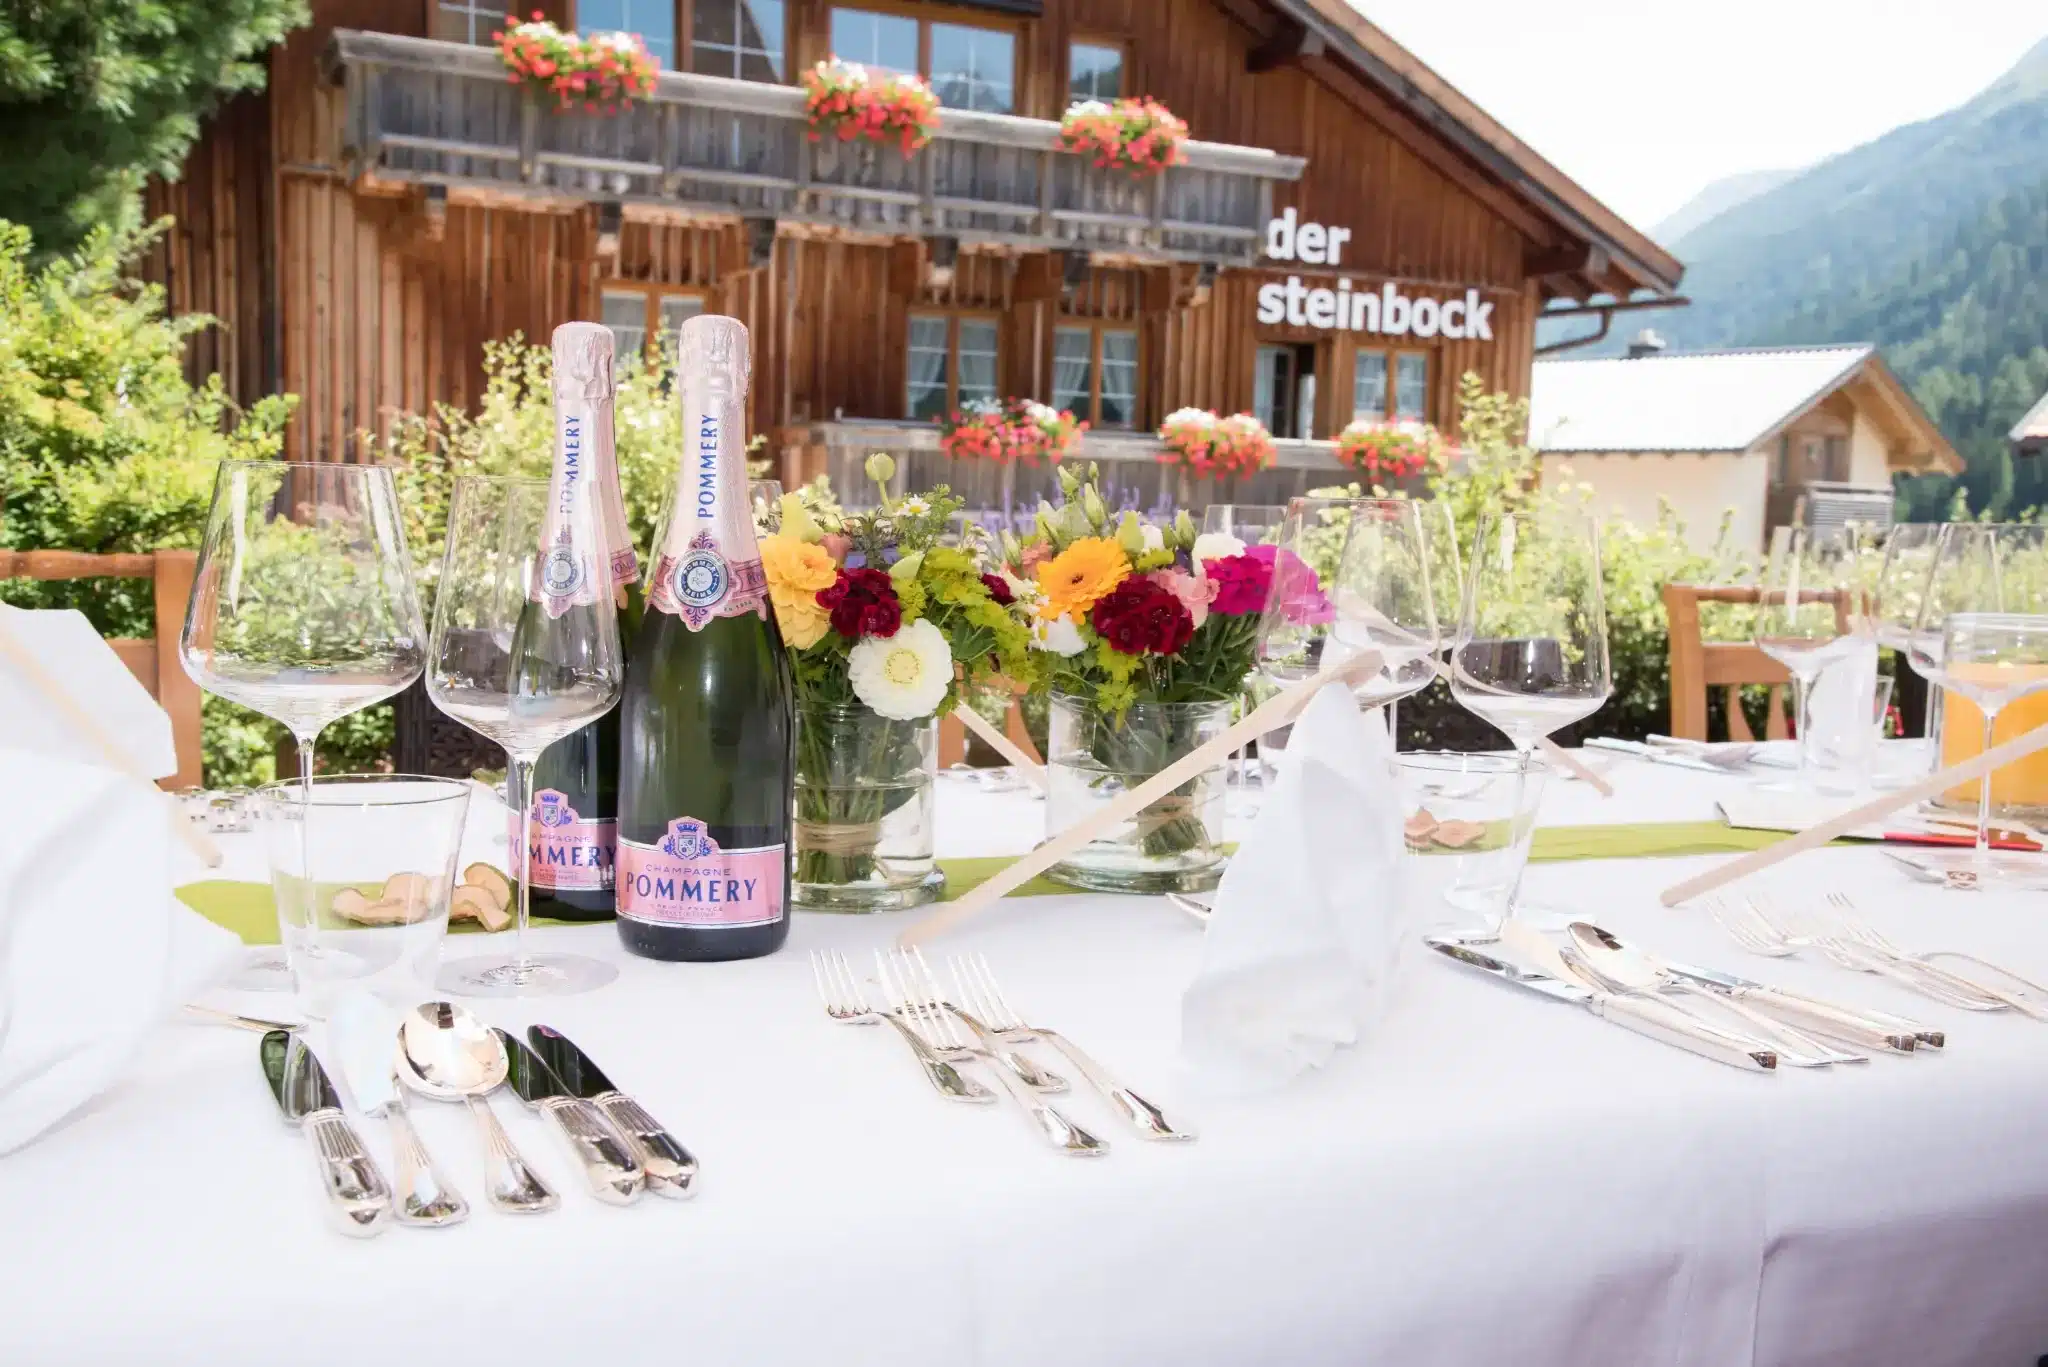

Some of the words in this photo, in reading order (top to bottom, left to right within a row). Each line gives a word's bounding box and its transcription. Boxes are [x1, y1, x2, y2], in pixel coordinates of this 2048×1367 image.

[1266, 206, 1351, 266] der
[1256, 275, 1495, 342] steinbock
[559, 415, 580, 514] POMMERY
[698, 414, 718, 519] POMMERY
[531, 833, 592, 843] AMPAGNE
[626, 871, 758, 903] POMMERY
[645, 863, 731, 877] CHAMPAGNE
